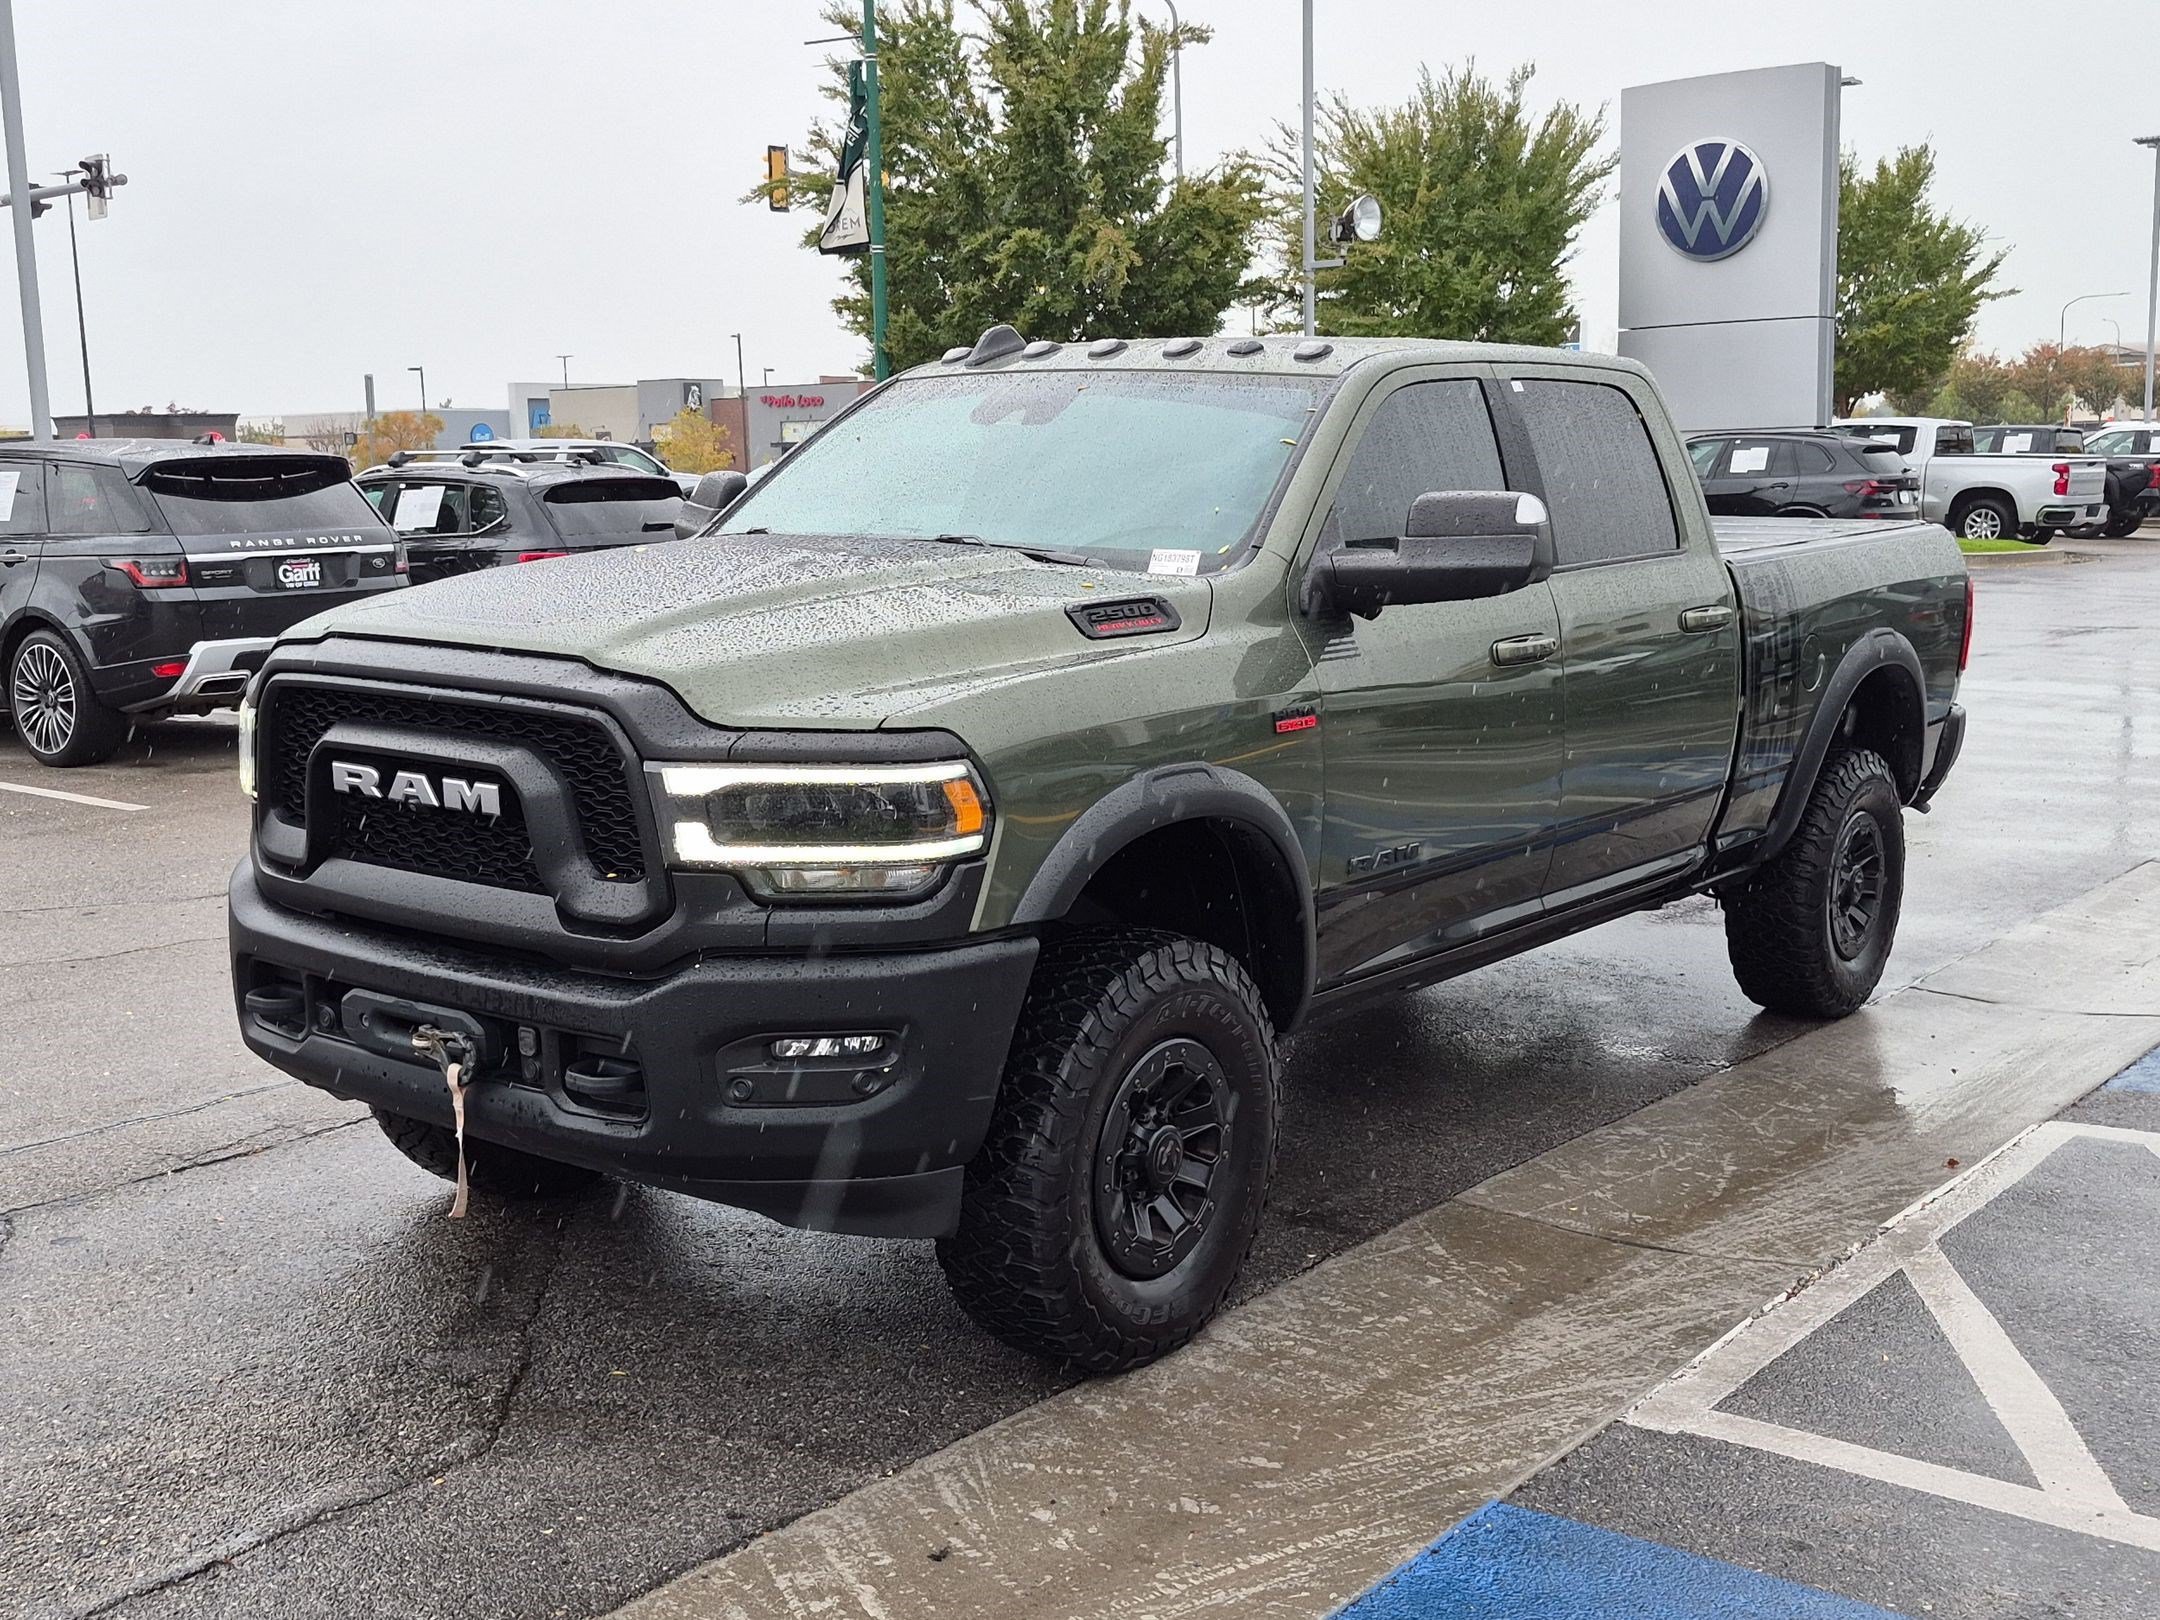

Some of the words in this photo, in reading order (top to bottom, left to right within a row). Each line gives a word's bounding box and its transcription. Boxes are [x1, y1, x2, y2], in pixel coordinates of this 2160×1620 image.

[798, 395, 824, 408] Loco
[230, 538, 295, 548] RANGE
[306, 535, 363, 544] ROVER
[278, 562, 321, 583] Garff
[1088, 602, 1155, 623] 2500
[331, 760, 501, 816] RAM
[1347, 842, 1419, 873] RAM
